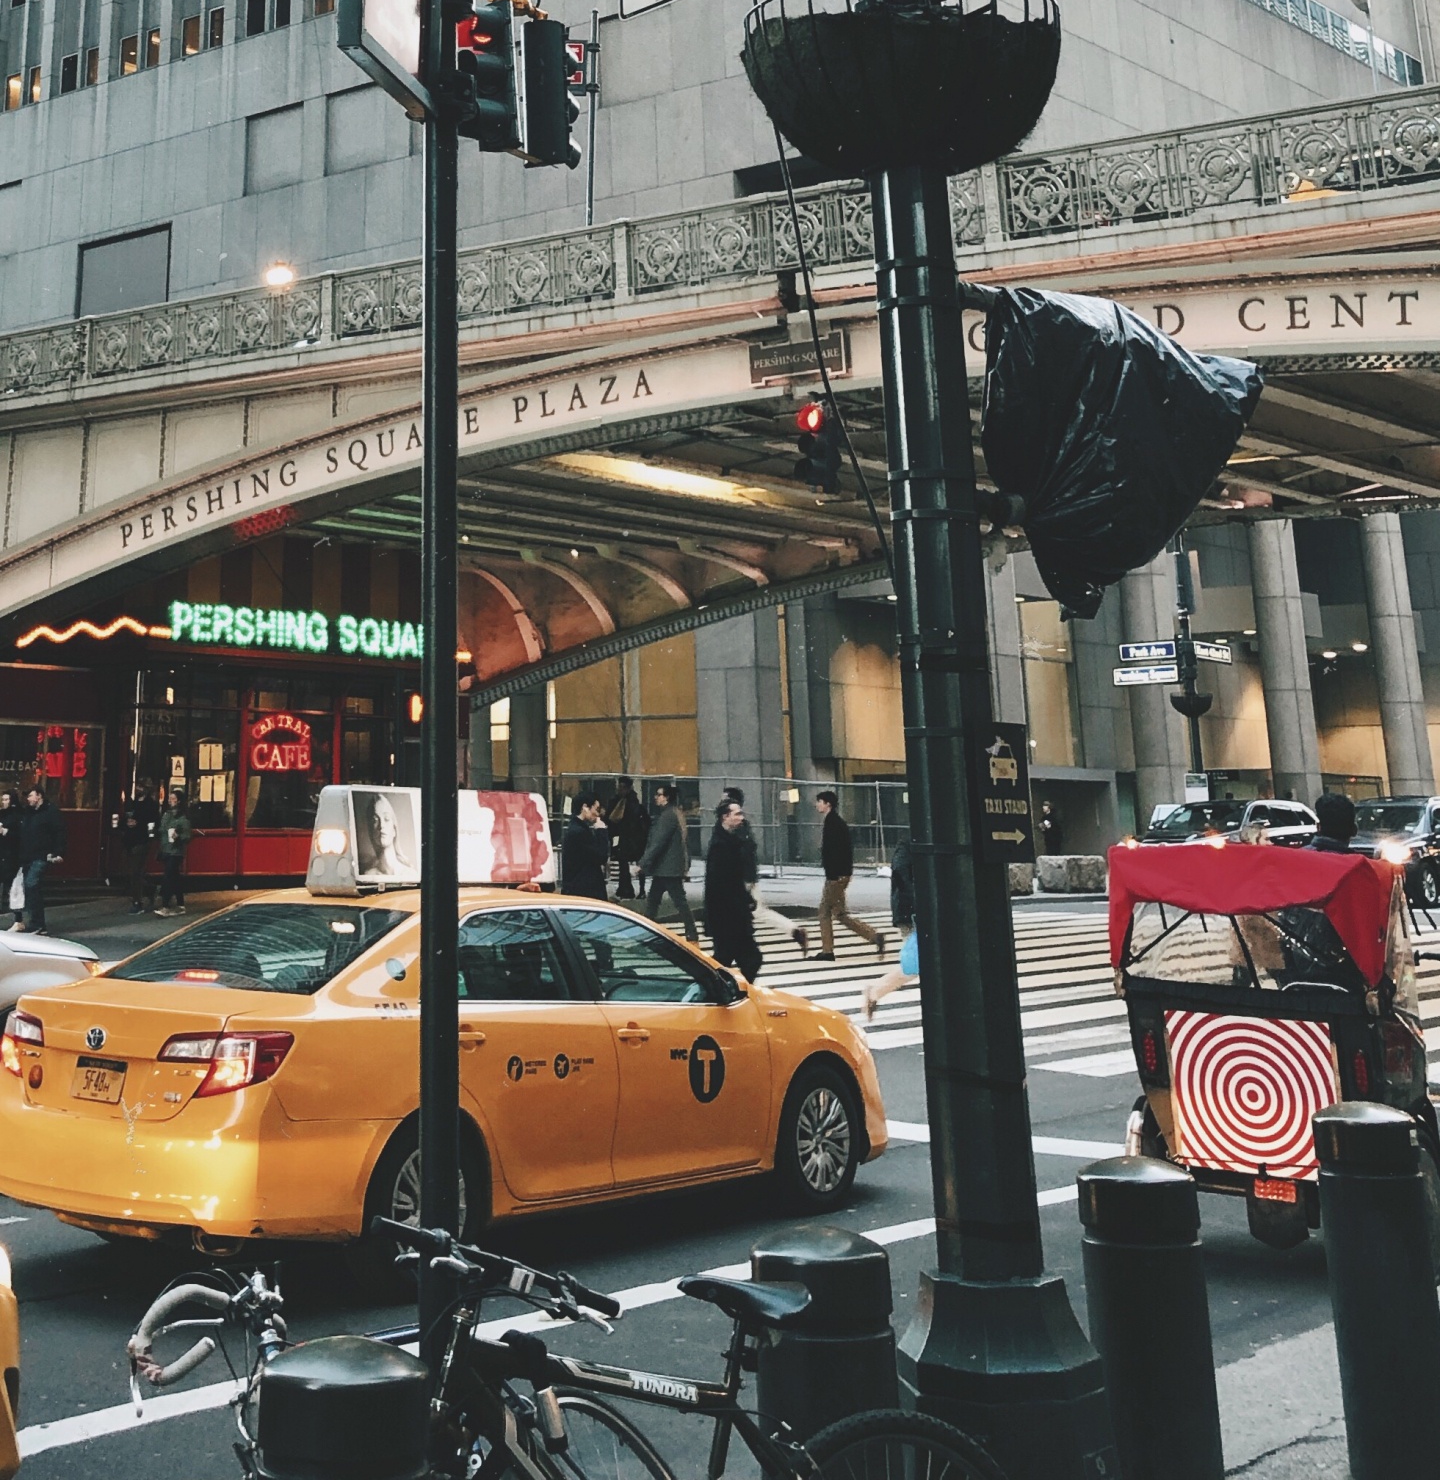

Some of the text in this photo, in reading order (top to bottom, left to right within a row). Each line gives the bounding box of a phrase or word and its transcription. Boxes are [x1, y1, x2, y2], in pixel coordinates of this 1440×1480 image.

[753, 354, 800, 369] PERSHING
[121, 369, 653, 548] PERSHING SQUAE PLAZA
[169, 600, 424, 658] PERSHING SQUA
[175, 759, 182, 771] A
[253, 743, 310, 770] CAFE
[985, 798, 1028, 815] TAXI STAND
[670, 1048, 717, 1094] NYC T
[629, 1372, 698, 1403] TUNDRA
